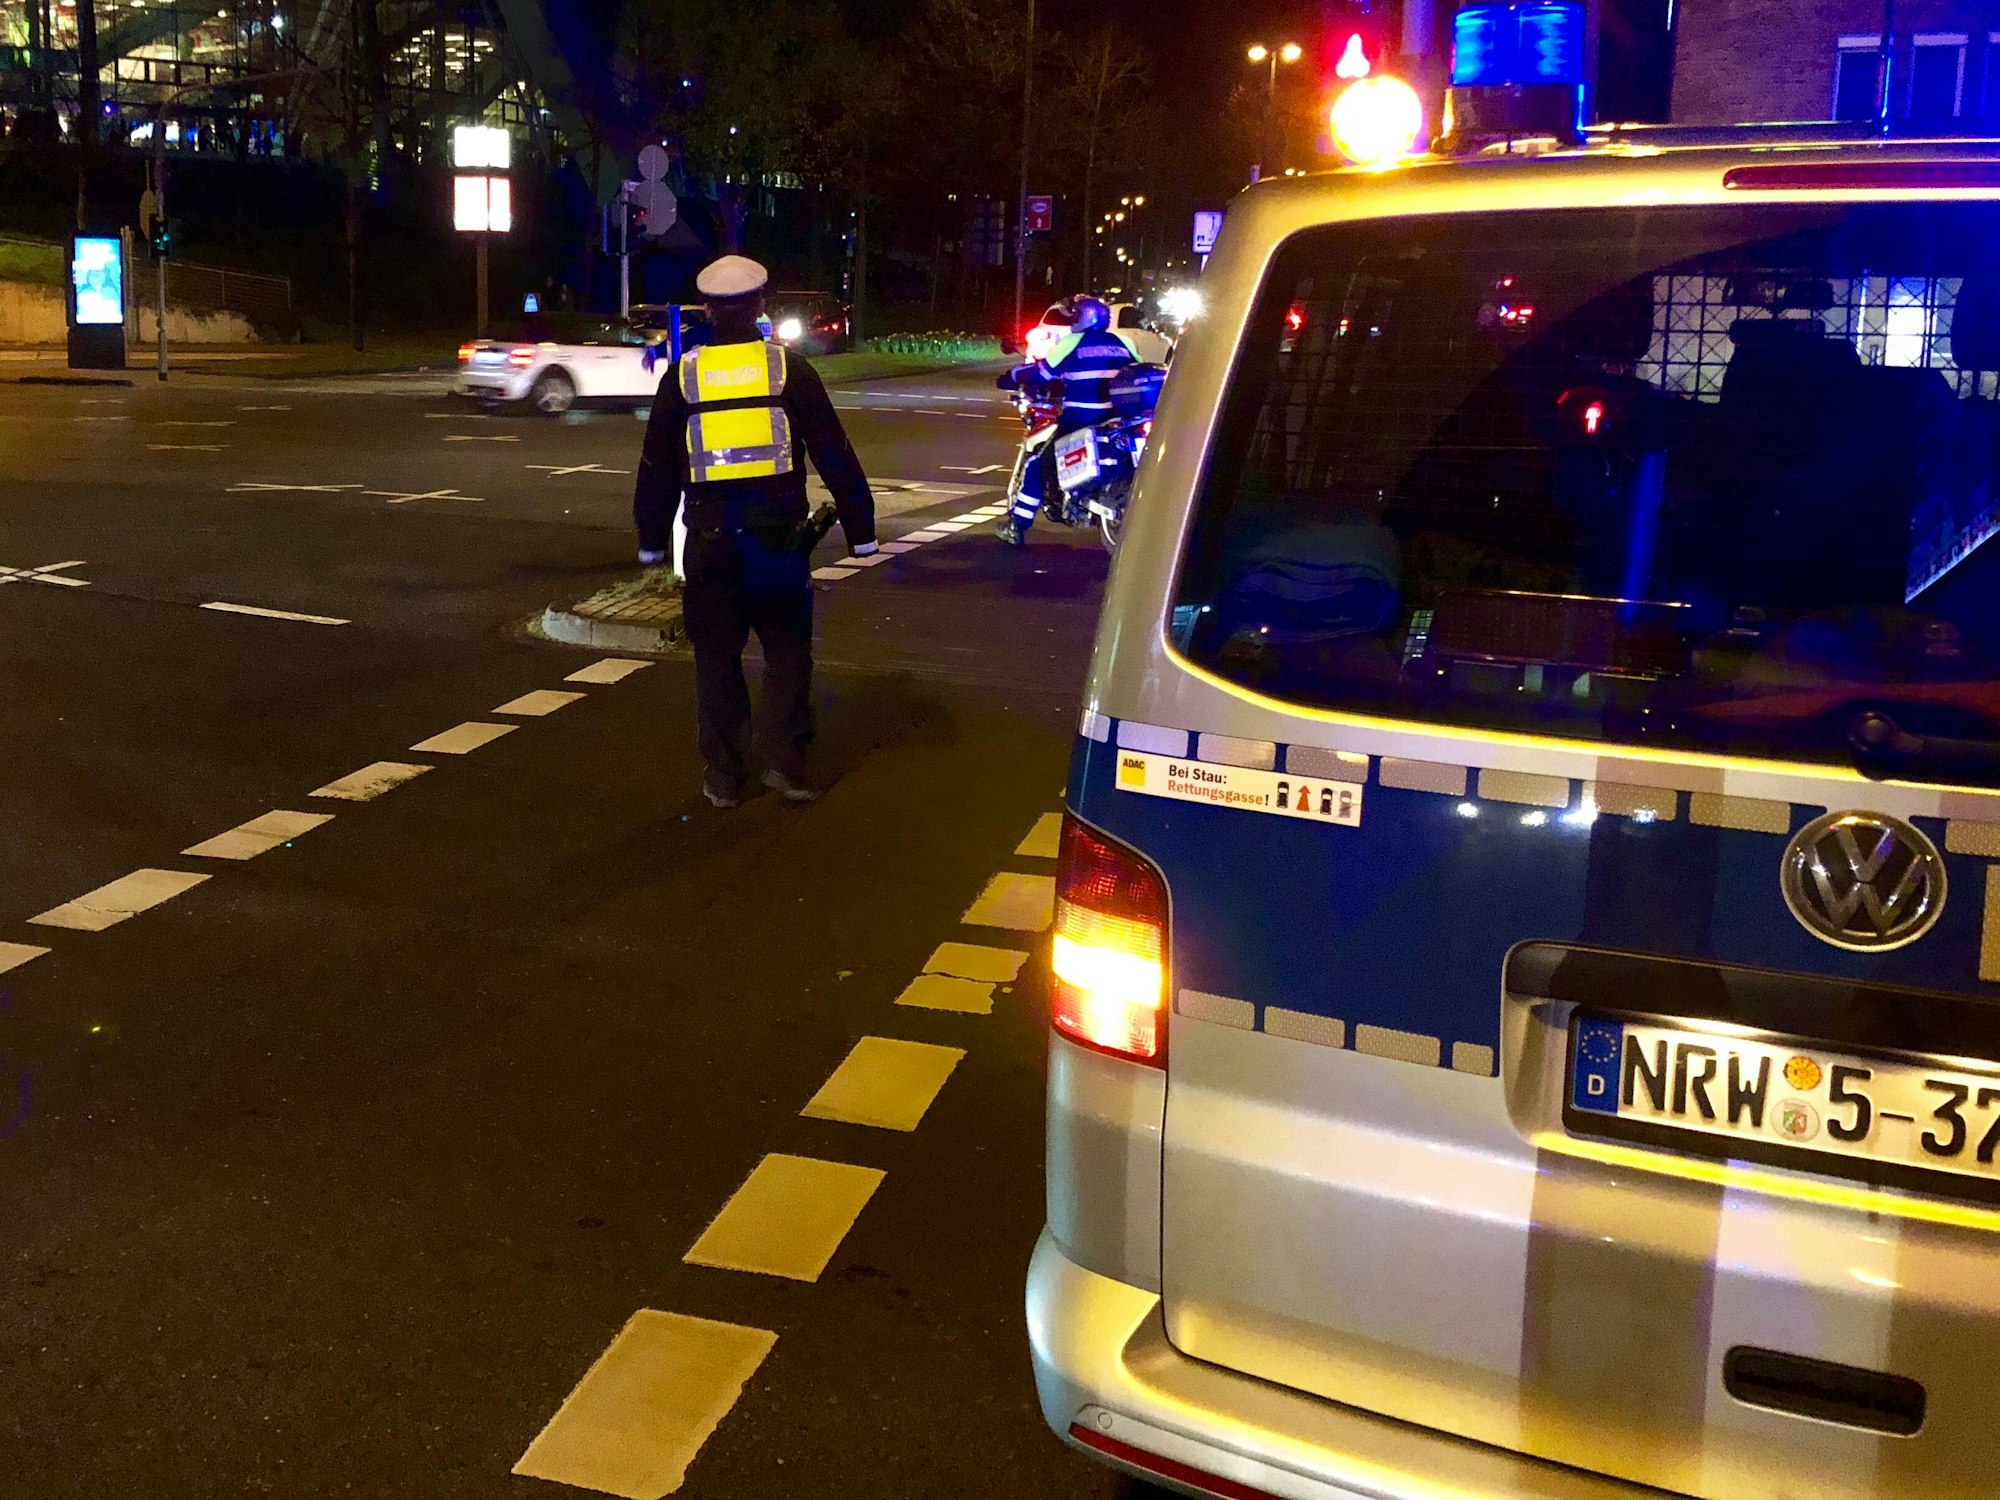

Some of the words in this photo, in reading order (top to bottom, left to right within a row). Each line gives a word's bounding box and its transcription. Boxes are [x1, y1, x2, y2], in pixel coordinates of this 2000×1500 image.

[1122, 758, 1145, 770] ADAC
[1169, 764, 1189, 778] Bei
[1193, 768, 1227, 784] Stau:
[1587, 1074, 1605, 1095] D
[1622, 1034, 1771, 1129] NRW
